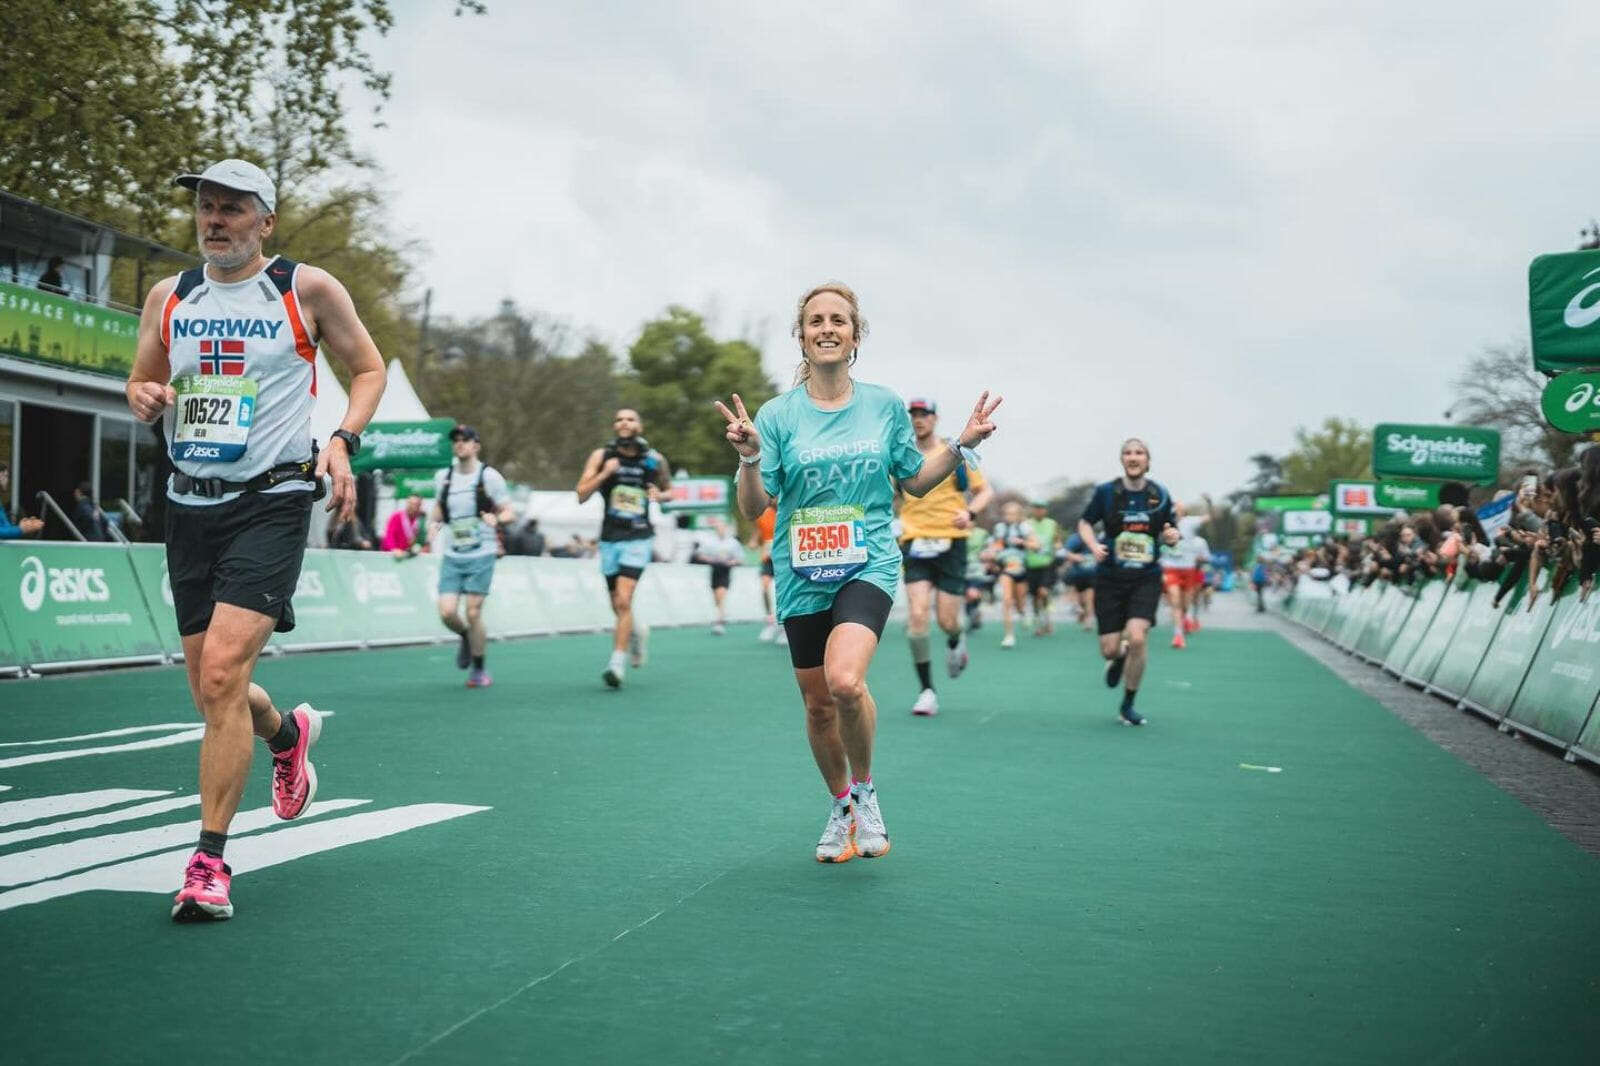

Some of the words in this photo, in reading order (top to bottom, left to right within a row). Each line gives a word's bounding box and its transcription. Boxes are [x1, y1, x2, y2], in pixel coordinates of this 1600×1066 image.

[173, 318, 283, 339] NORWAY
[184, 397, 232, 426] 10522
[193, 447, 220, 457] asics
[799, 440, 881, 464] GROUPE
[1387, 433, 1487, 456] Schneider
[803, 458, 881, 489] RATP
[798, 524, 850, 552] 25350
[821, 567, 846, 578] asics
[48, 568, 110, 602] asics
